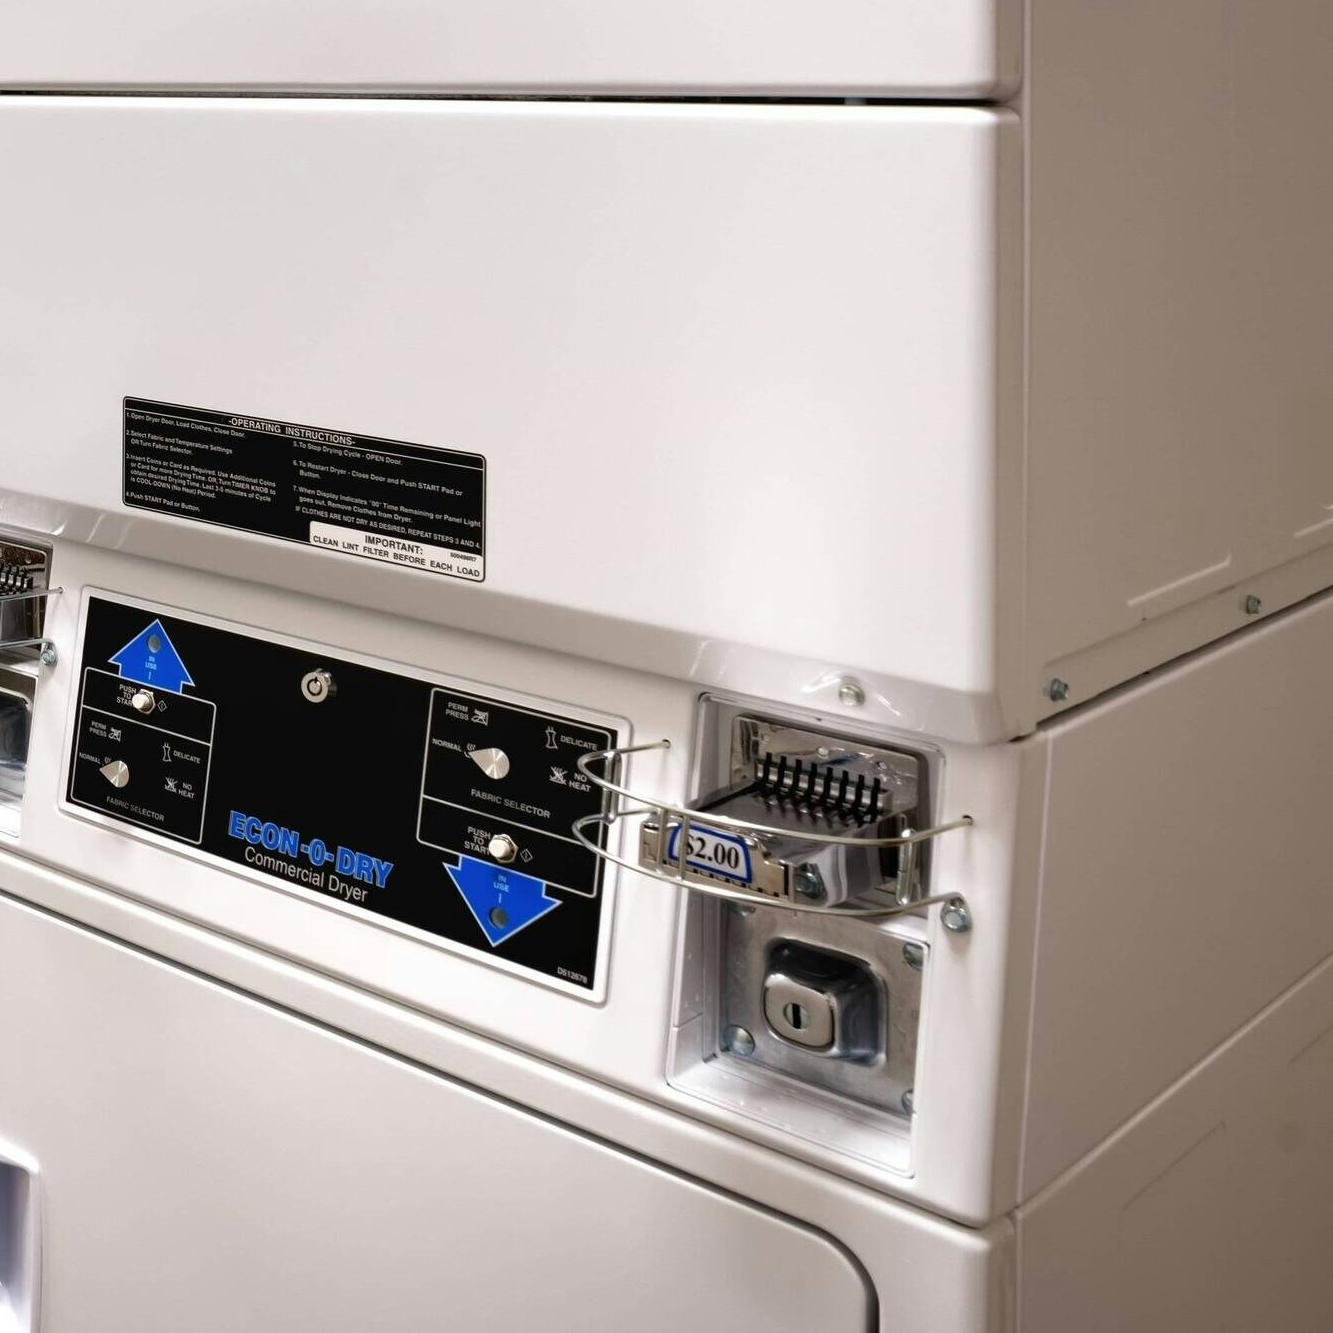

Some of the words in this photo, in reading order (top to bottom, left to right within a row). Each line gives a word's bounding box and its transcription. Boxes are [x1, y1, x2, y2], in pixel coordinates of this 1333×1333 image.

[365, 535, 423, 555] IMPORTANT:
[313, 535, 338, 548] CLEAN
[342, 541, 359, 552] LINT
[363, 546, 389, 558] FILTER
[394, 552, 425, 566] BEFORE
[430, 560, 452, 572] EACH
[457, 566, 479, 578] LOAD
[145, 662, 157, 670] USE
[119, 684, 136, 694] PUSH
[448, 702, 468, 713] PERM
[445, 708, 469, 721] PRESS
[92, 721, 106, 730] PERM
[89, 727, 107, 738] PRESS
[433, 738, 461, 752] NORMAL
[560, 735, 598, 751] DELICATE
[79, 752, 101, 764] NORMAL
[173, 750, 201, 764] DELICATE
[574, 773, 587, 782] NO
[183, 782, 192, 790] NO
[569, 781, 591, 792] HEAT
[178, 789, 194, 799] HEAT
[107, 796, 129, 810] FABRIC
[130, 804, 164, 822] SELECTOR
[471, 789, 502, 805] FABRIC
[504, 799, 550, 818] SELECTOR
[468, 826, 491, 839] PUSH
[474, 836, 484, 845] TO
[245, 846, 324, 887] Commercial
[328, 875, 368, 902] Dryer
[498, 874, 506, 882] IN
[493, 882, 509, 892] USE
